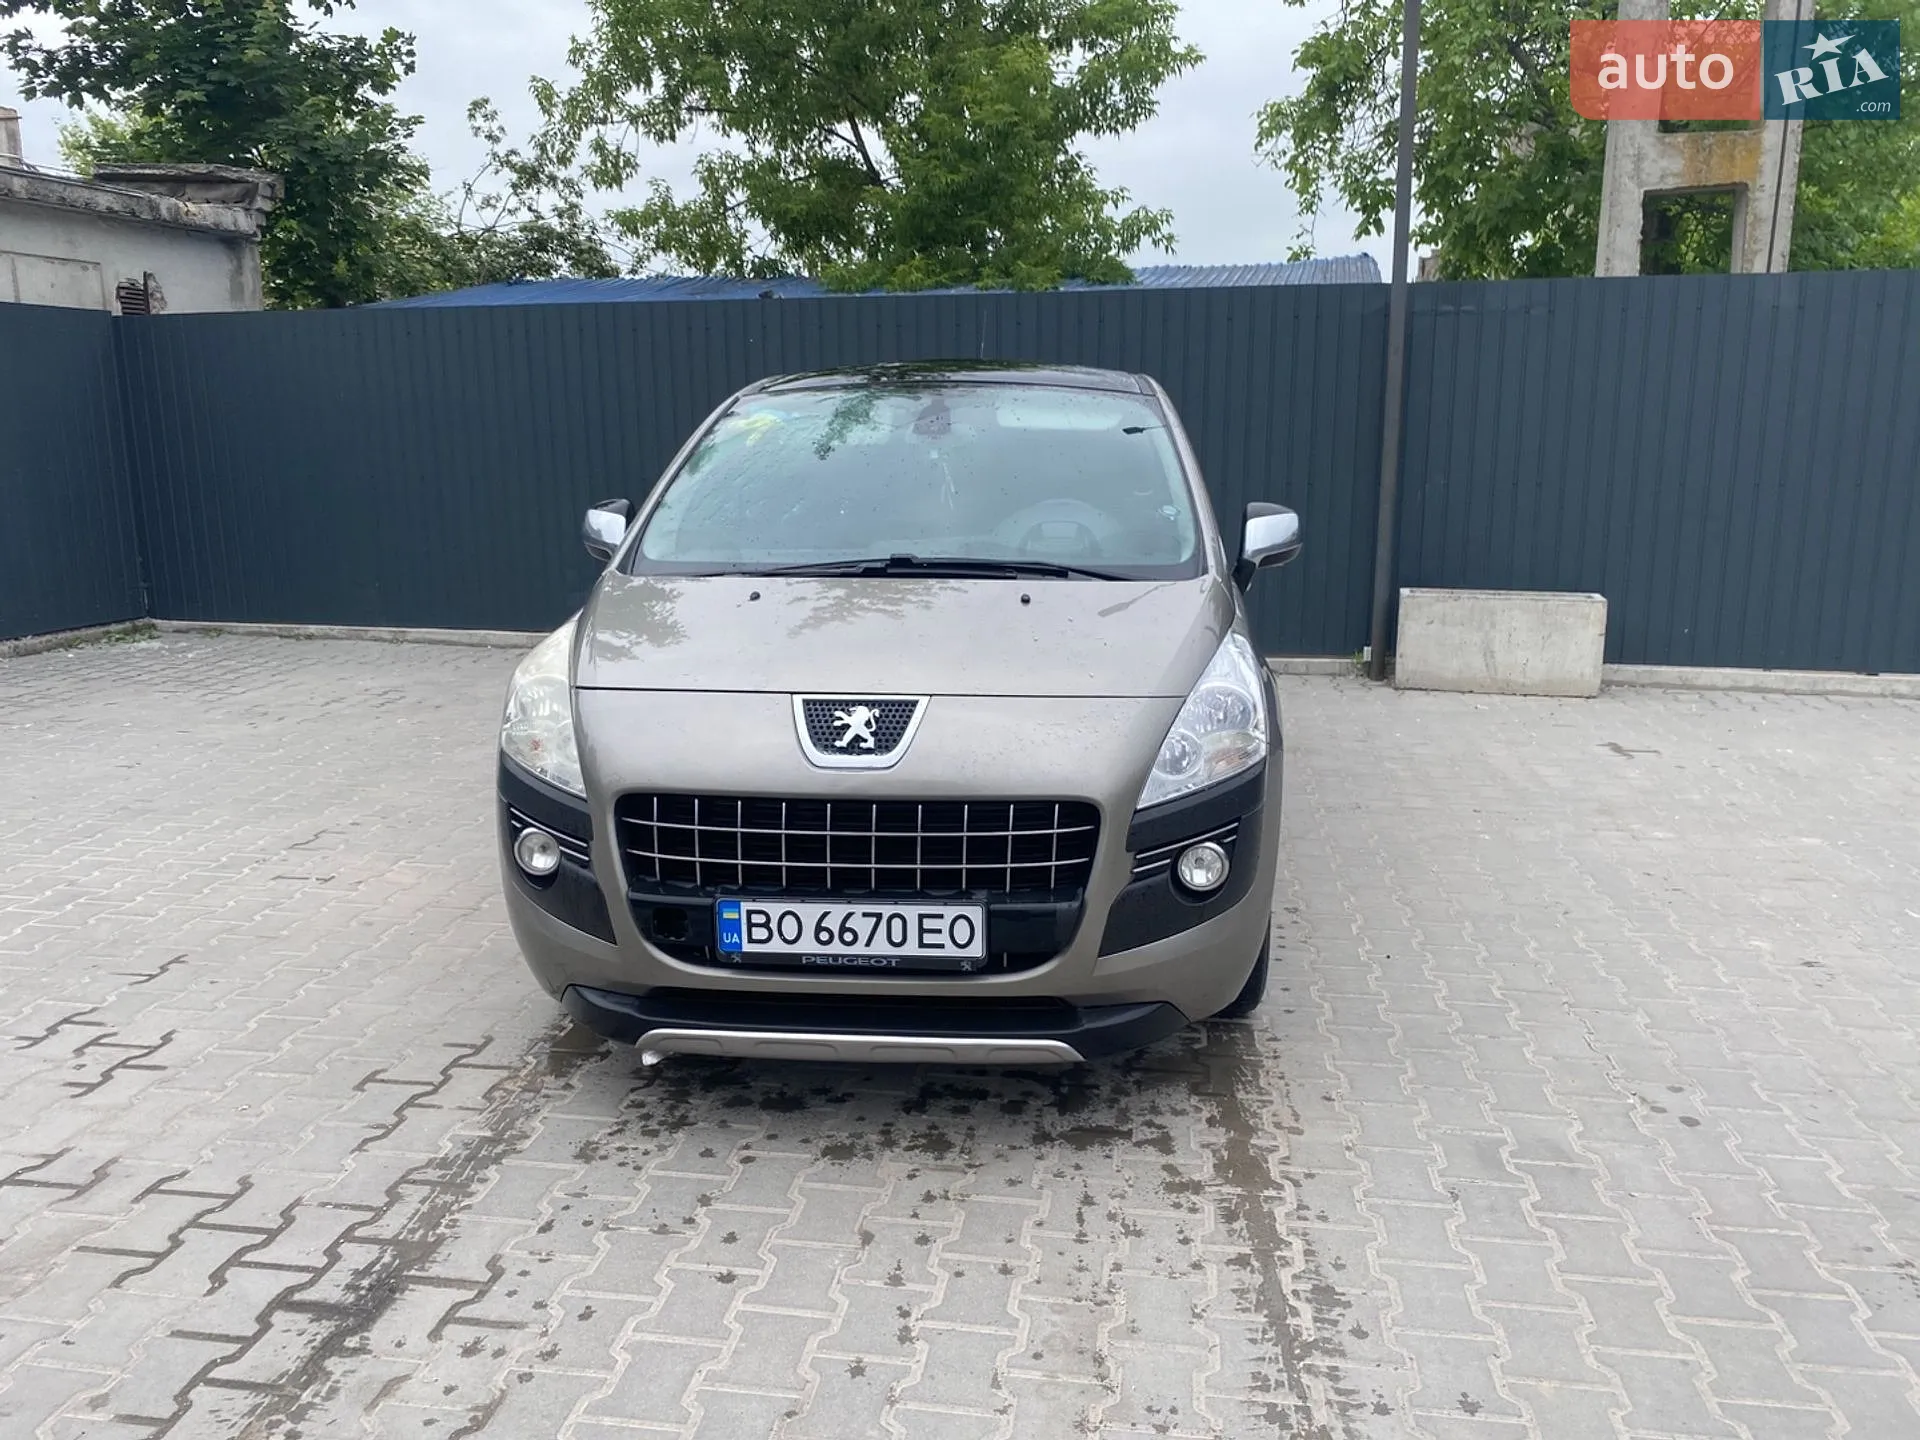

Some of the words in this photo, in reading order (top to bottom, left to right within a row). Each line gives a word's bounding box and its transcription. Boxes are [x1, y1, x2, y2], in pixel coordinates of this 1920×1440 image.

[745, 909, 803, 945] BO
[813, 911, 908, 948] 6670
[917, 913, 976, 950] EO
[722, 932, 740, 944] UA
[801, 955, 901, 967] PEUGEOT
